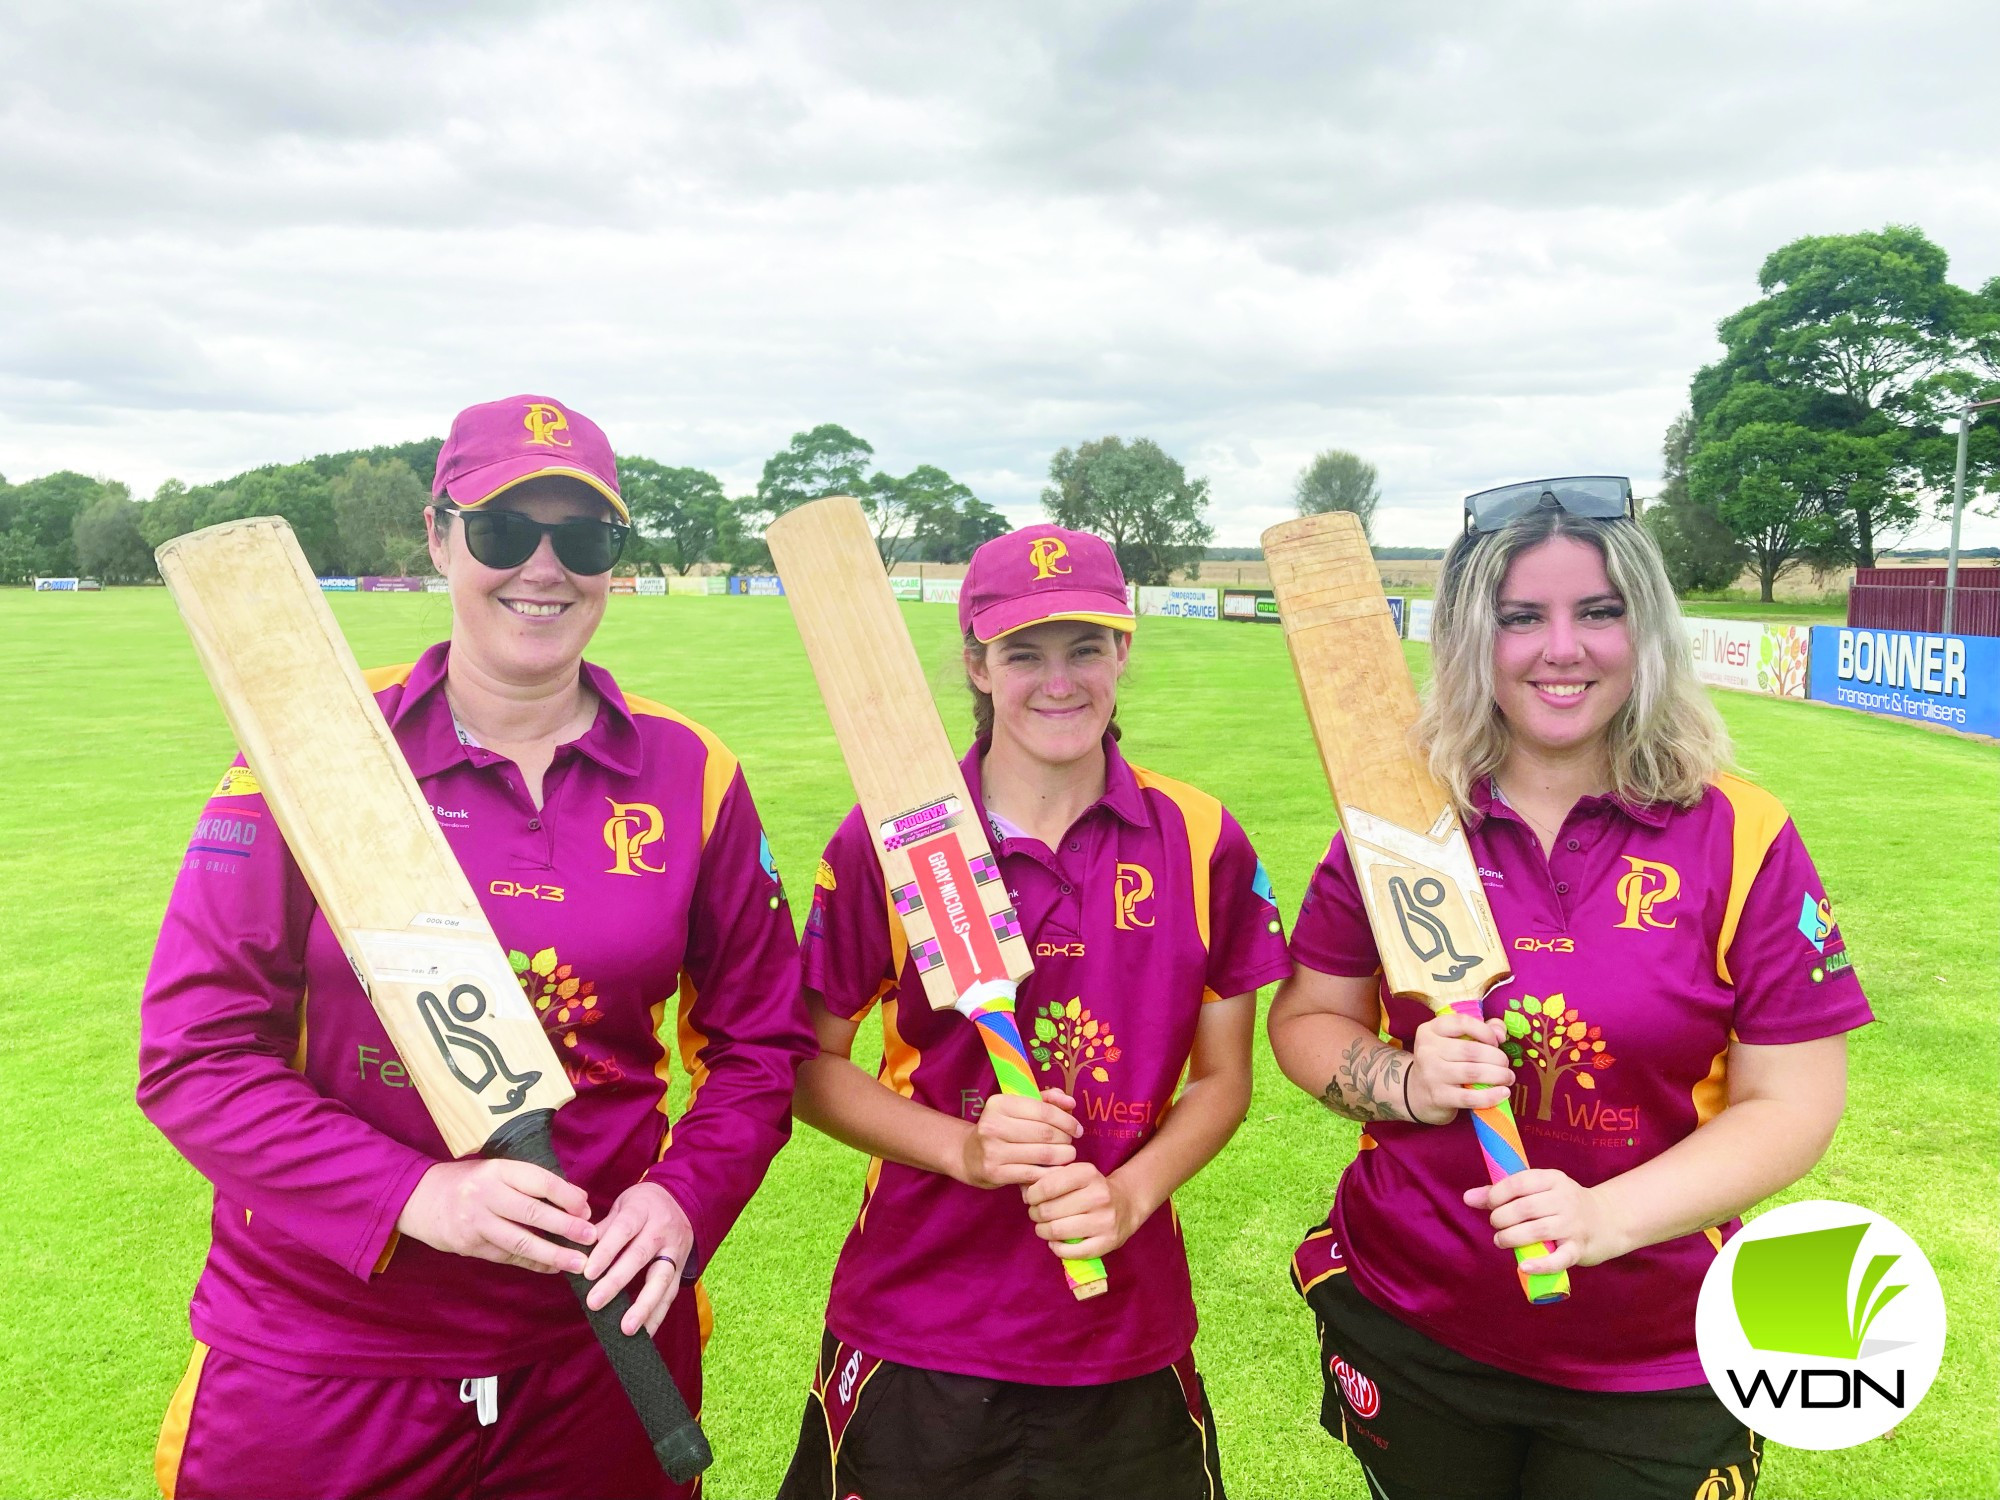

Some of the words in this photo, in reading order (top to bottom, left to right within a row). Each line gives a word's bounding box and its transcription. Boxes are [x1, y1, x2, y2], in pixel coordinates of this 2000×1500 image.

[1182, 602, 1216, 618] SERVICES
[1713, 629, 1750, 668] West
[1838, 629, 1967, 699] BONNER
[1837, 685, 1890, 710] transport
[1891, 692, 1903, 712] &
[437, 805, 469, 819] Bank
[893, 803, 948, 833] KABOOM!
[1478, 867, 1503, 880] Bank
[489, 880, 565, 902] QX3
[1036, 943, 1085, 957] QX3
[1514, 937, 1575, 953] QX3
[358, 1044, 413, 1088] Fe
[1082, 1089, 1152, 1124] West
[1564, 1093, 1640, 1131] West
[1524, 1125, 1588, 1146] FINANCIAL
